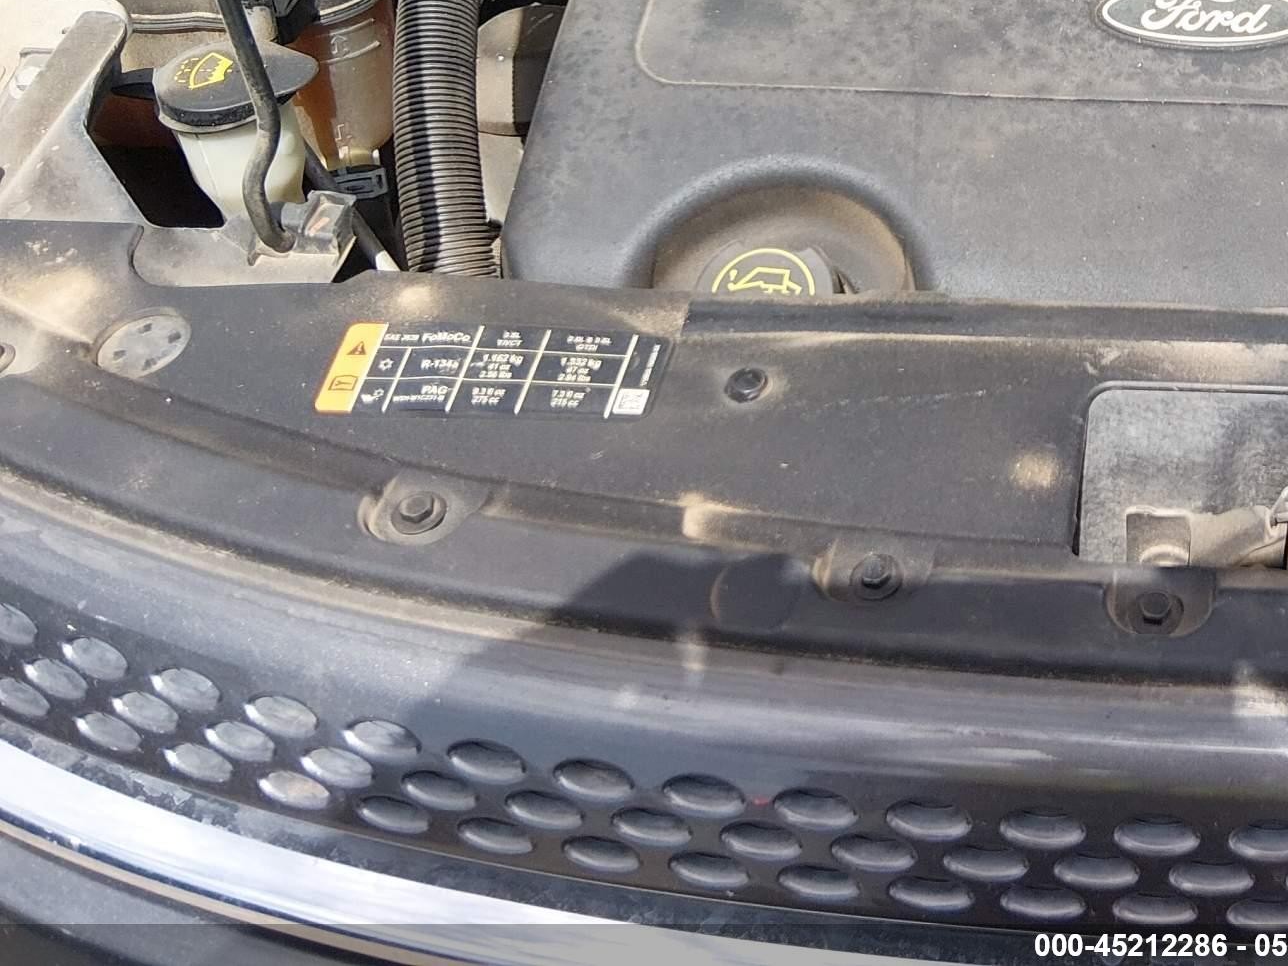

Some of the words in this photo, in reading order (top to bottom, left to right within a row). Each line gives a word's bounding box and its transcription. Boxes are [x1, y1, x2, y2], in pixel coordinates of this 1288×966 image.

[421, 331, 472, 343] FoMoCo
[421, 358, 460, 370] R-134a
[509, 353, 524, 367] kg
[587, 357, 602, 370] kg
[421, 385, 448, 395] PAG
